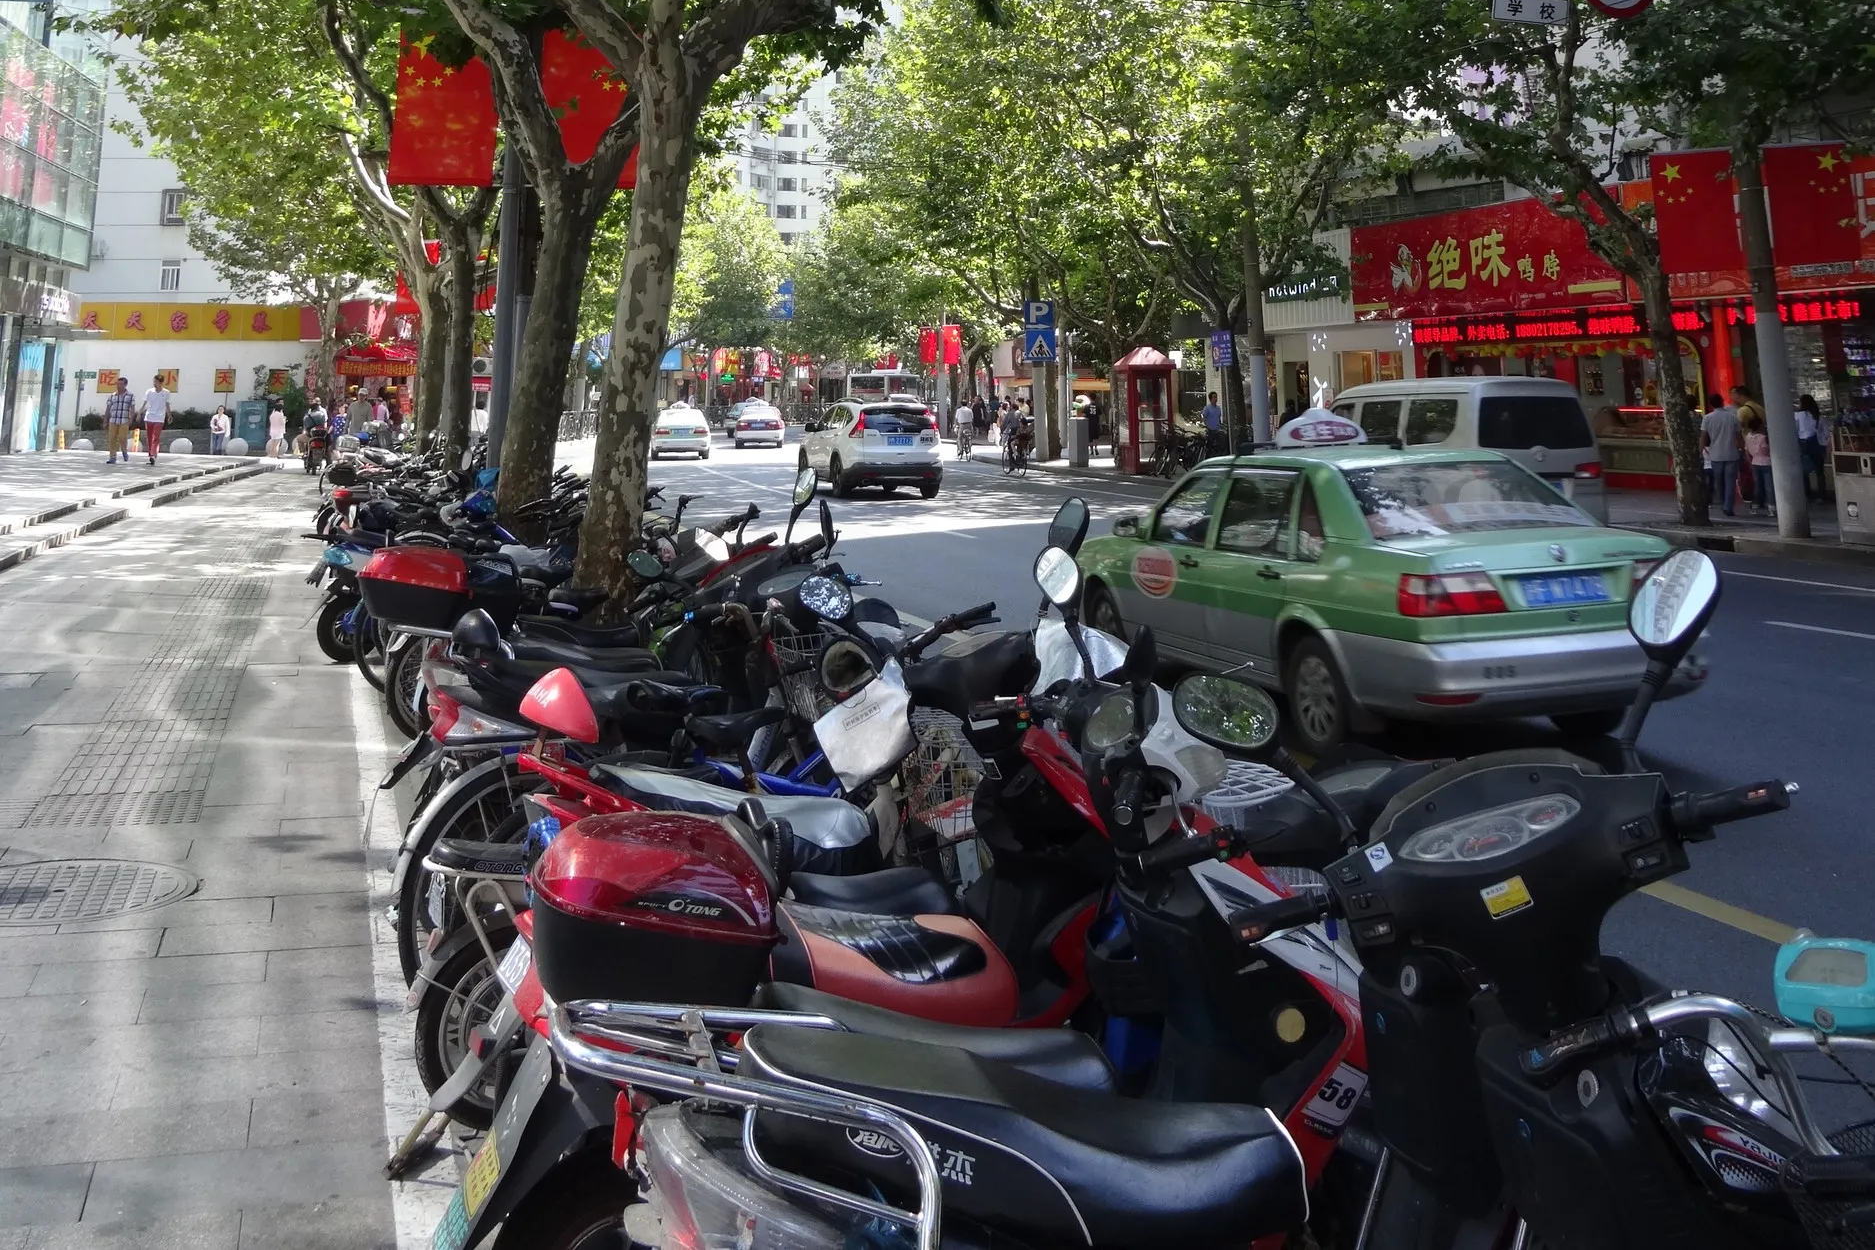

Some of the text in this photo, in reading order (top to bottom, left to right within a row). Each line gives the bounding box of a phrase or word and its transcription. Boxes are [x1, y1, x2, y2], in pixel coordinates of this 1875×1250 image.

[1426, 228, 1561, 290] 绝味鸭脖
[82, 309, 272, 334] 天天家常菜
[1029, 302, 1049, 323] P
[1318, 1077, 1357, 1111] 58
